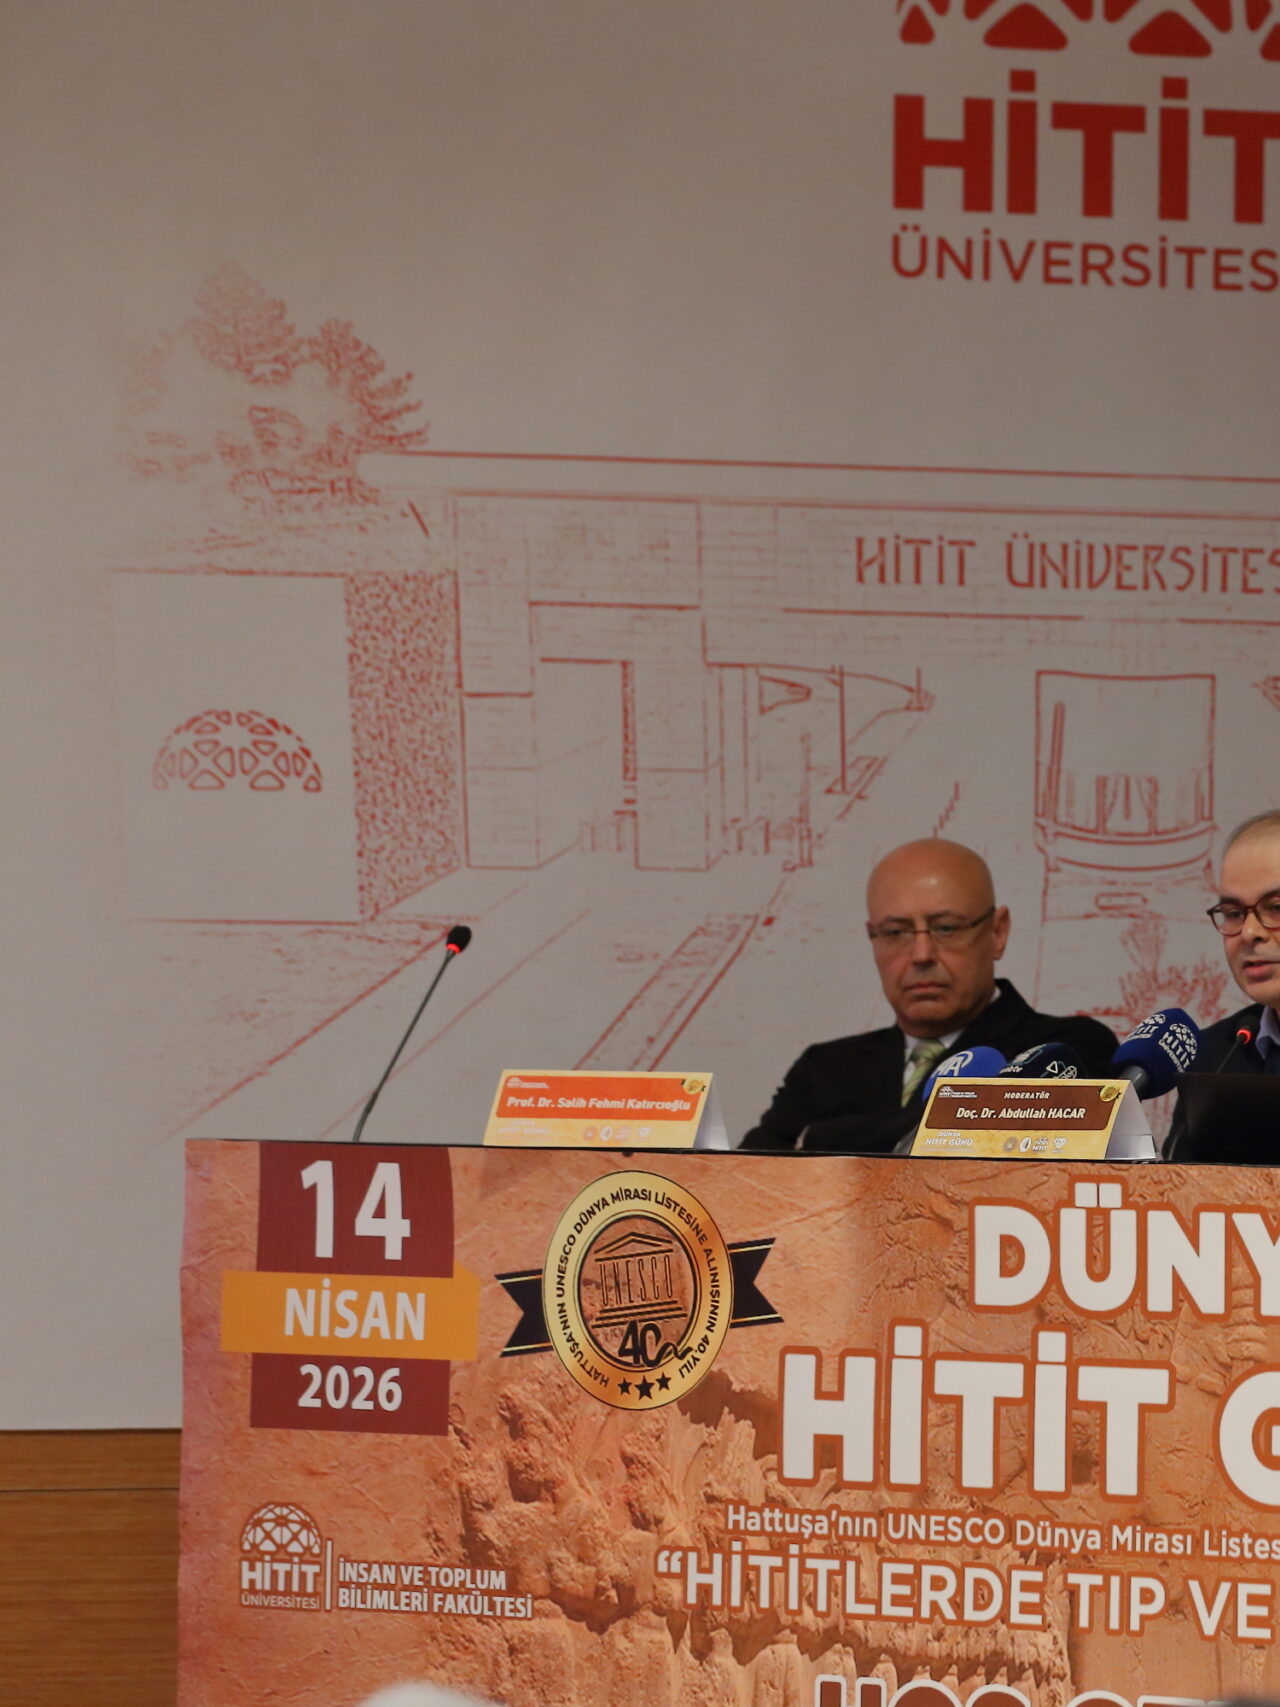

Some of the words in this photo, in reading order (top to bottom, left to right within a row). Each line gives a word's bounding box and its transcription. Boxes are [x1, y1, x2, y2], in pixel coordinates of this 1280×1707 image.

[855, 535, 976, 586] HİTİT
[506, 1096, 535, 1108] Prof.
[537, 1096, 555, 1108] Dr.
[557, 1097, 587, 1109] Salih
[588, 1098, 625, 1110] Fehmi
[956, 1107, 979, 1120] Doç.
[981, 1108, 997, 1119] Dr.
[998, 1108, 1047, 1119] Abdullah
[1047, 1109, 1086, 1120] HACAR
[1004, 1090, 1050, 1100] MODERATÖR
[300, 1160, 411, 1261] 14
[574, 1198, 610, 1233] DÜNYA
[610, 1187, 652, 1204] MİRASI
[655, 1191, 709, 1245] LİSTESİNE
[556, 1235, 577, 1297] UNESCO
[599, 1255, 673, 1306] UNESCO
[703, 1248, 721, 1333] ALINIŞININ
[284, 1277, 426, 1341] NİSAN
[556, 1302, 611, 1387] HATTUŞA'NIN
[298, 1363, 402, 1412] 2026
[780, 1326, 1172, 1497] HİTİT
[887, 1512, 1005, 1545] UNESCO
[1016, 1518, 1101, 1556] Dünya
[1111, 1525, 1193, 1555] Mirası
[241, 1555, 321, 1593] HİTİT
[339, 1558, 397, 1585] İNSAN
[400, 1564, 426, 1587] VE
[428, 1566, 507, 1591] TOPLUM
[241, 1593, 321, 1610] ÜNİVERSİTESİ
[338, 1584, 428, 1613] BİLİMLERİ
[433, 1590, 533, 1619] FAKÜLTESİ
[1067, 1573, 1167, 1632] TIP
[1187, 1580, 1273, 1640] VE
